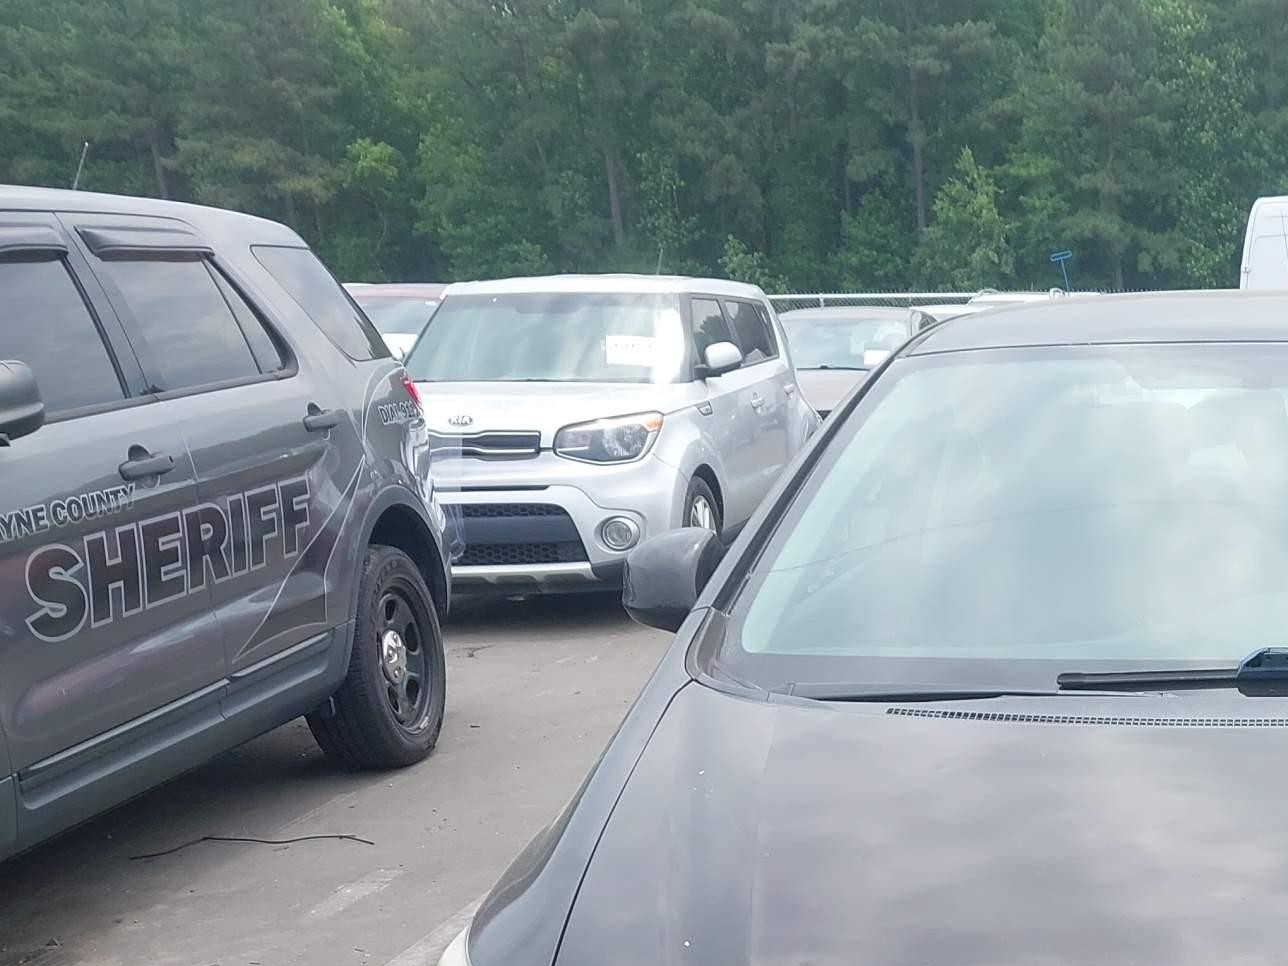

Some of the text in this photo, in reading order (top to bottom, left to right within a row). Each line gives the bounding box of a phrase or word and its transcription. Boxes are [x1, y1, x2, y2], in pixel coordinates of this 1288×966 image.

[449, 416, 472, 425] KIA
[0, 484, 136, 543] YNE COUNTY
[25, 474, 311, 643] SHERIFF
